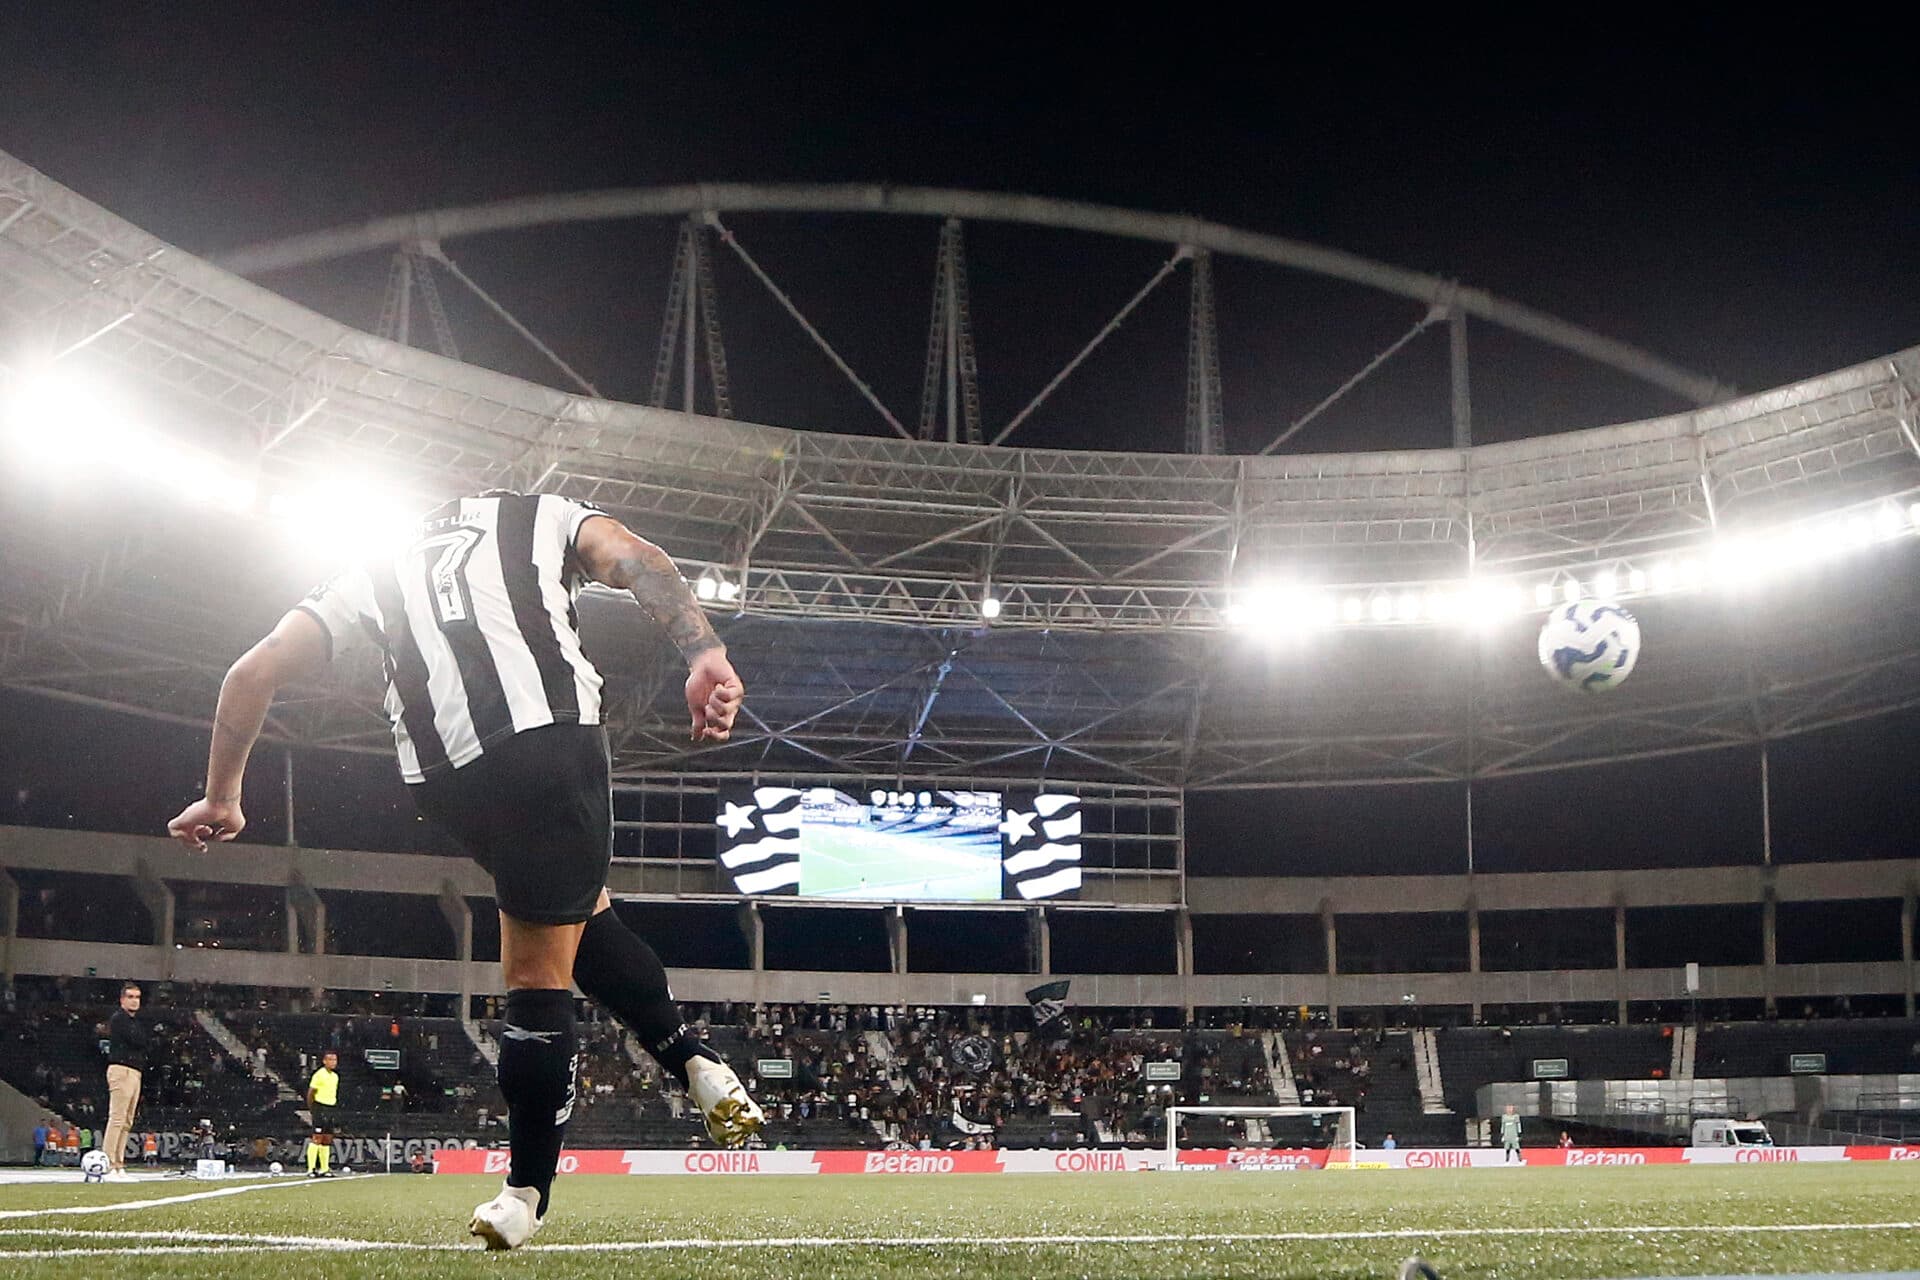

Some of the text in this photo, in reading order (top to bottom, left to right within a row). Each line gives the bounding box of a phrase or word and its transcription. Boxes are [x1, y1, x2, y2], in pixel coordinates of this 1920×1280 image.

[409, 511, 482, 537] RTUR
[406, 526, 486, 622] 7
[684, 1152, 760, 1173] CONFIA
[864, 1152, 954, 1173] Betano
[1055, 1152, 1126, 1172] CONFIA
[1565, 1149, 1645, 1166] Betano
[1735, 1149, 1799, 1163] CONFIA
